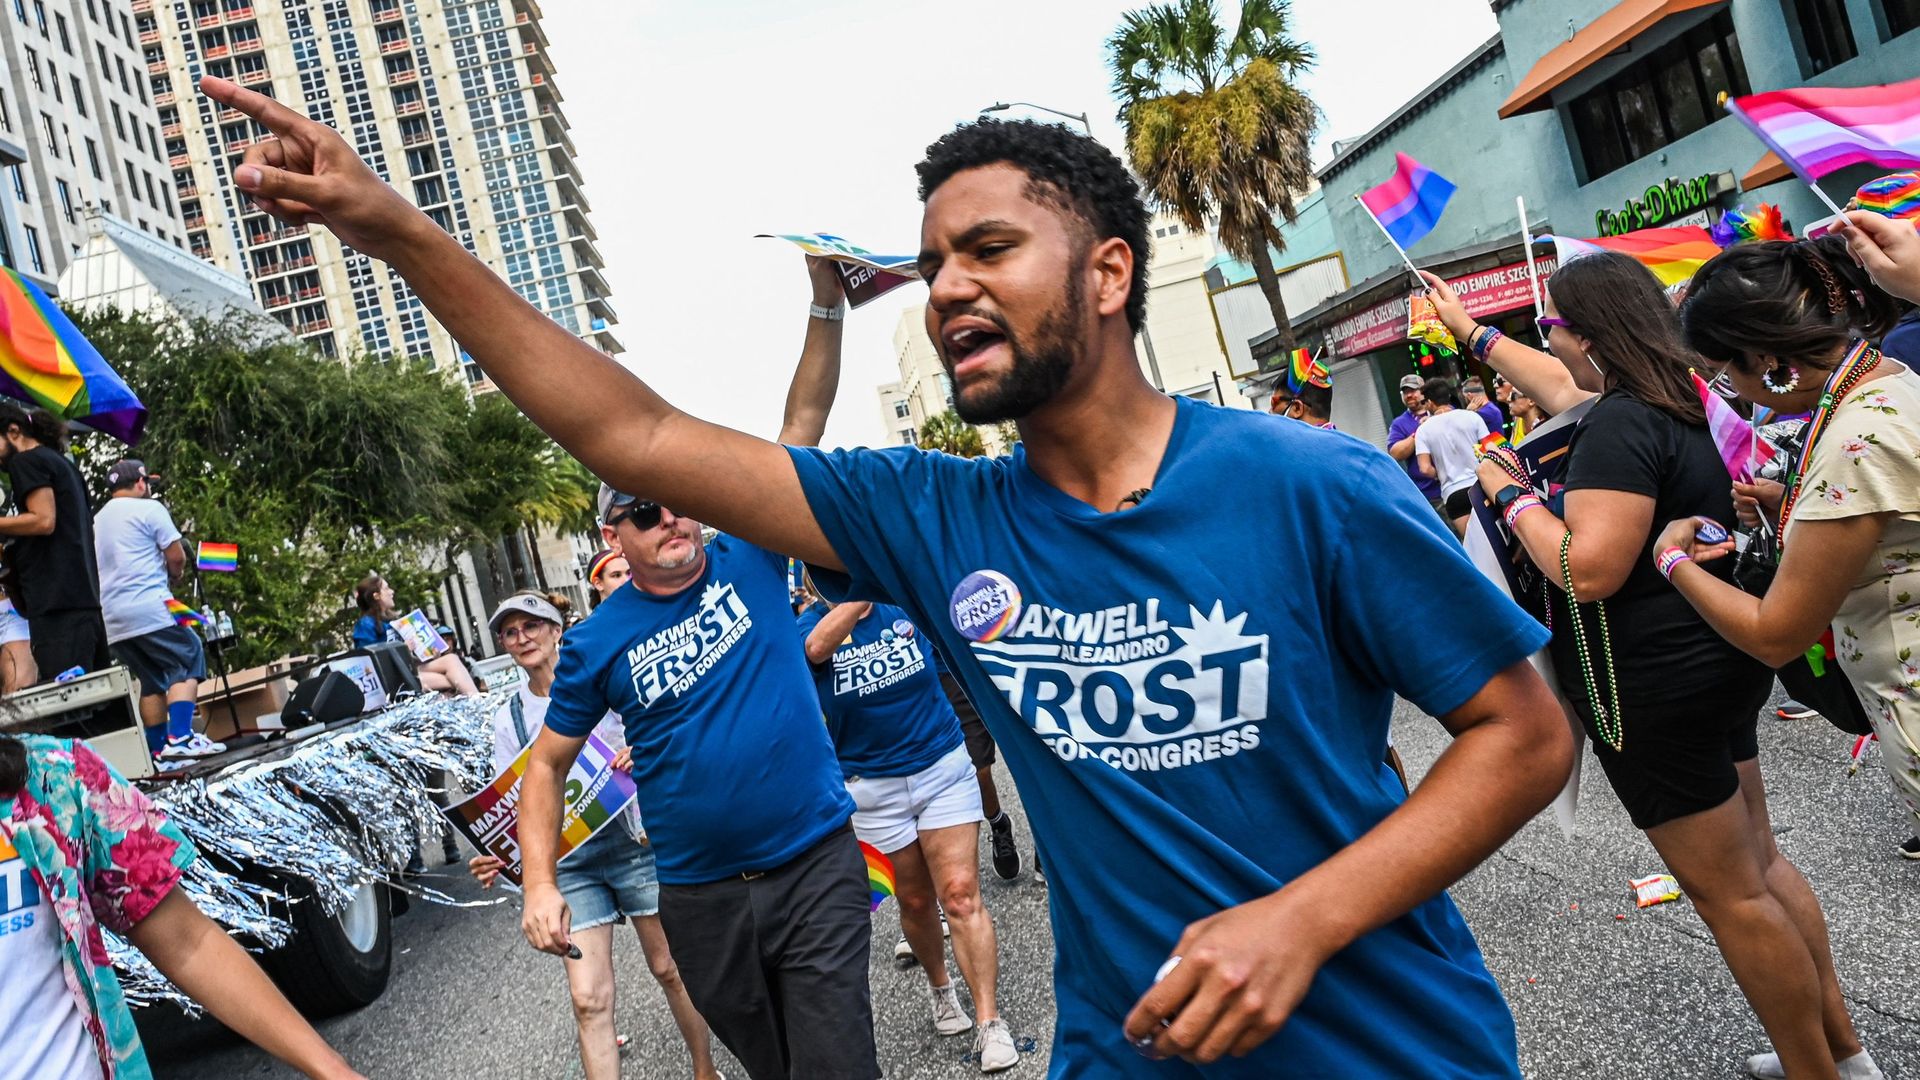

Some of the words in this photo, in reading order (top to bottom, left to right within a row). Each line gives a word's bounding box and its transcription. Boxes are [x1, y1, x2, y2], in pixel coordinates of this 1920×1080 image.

[1644, 173, 1711, 225] Diner
[1469, 271, 1506, 292] EMPIRE
[1506, 259, 1557, 283] SZECAUN
[1331, 319, 1357, 343] ORLANDO
[1354, 309, 1377, 333] EMPIRE
[959, 589, 1010, 627] FROST
[1007, 598, 1169, 646] AXWELL
[635, 587, 739, 704] FROST
[672, 673, 698, 699] FOR
[695, 615, 753, 677] CONGRESS
[832, 639, 889, 663] MAXWELL
[835, 640, 917, 694] FROST
[1059, 634, 1171, 664] ALEJANDRO
[859, 684, 878, 698] FOR
[879, 660, 926, 689] CONGRESS
[1099, 724, 1261, 772] CONGRESS
[571, 765, 614, 819] CONGRESS
